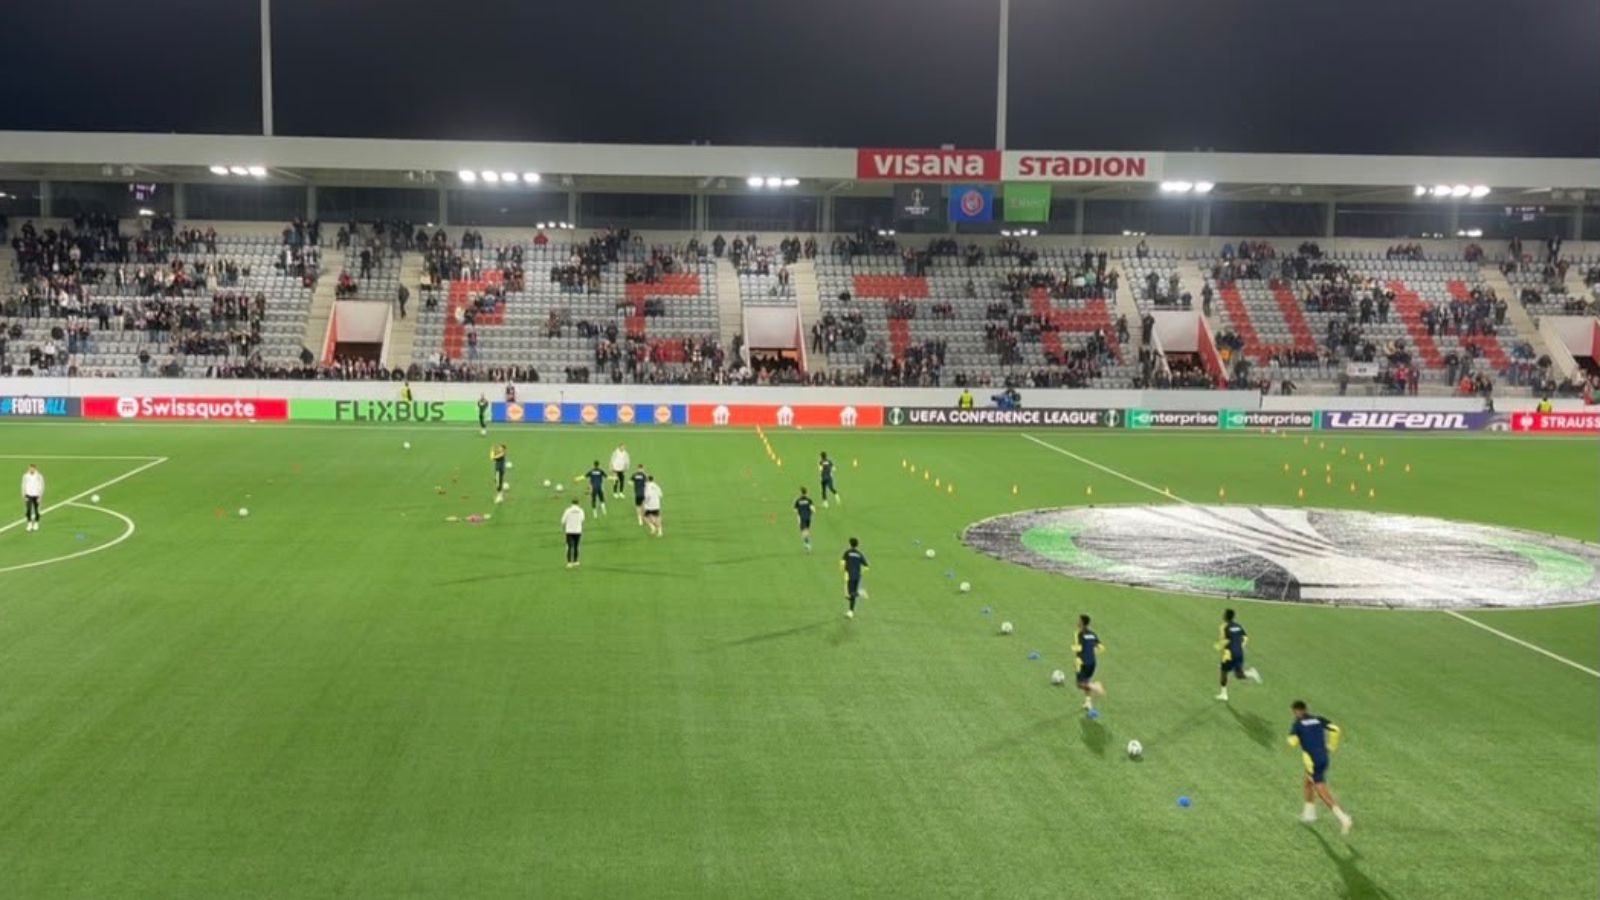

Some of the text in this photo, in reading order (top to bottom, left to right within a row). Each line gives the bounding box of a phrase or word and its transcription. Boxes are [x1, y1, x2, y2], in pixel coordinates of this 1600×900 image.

[141, 398, 256, 419] Swissquote
[909, 409, 1099, 425] UEFA CONFERENCE LEAGUE
[1138, 412, 1219, 427] enterprise
[1231, 413, 1312, 427] enterprise
